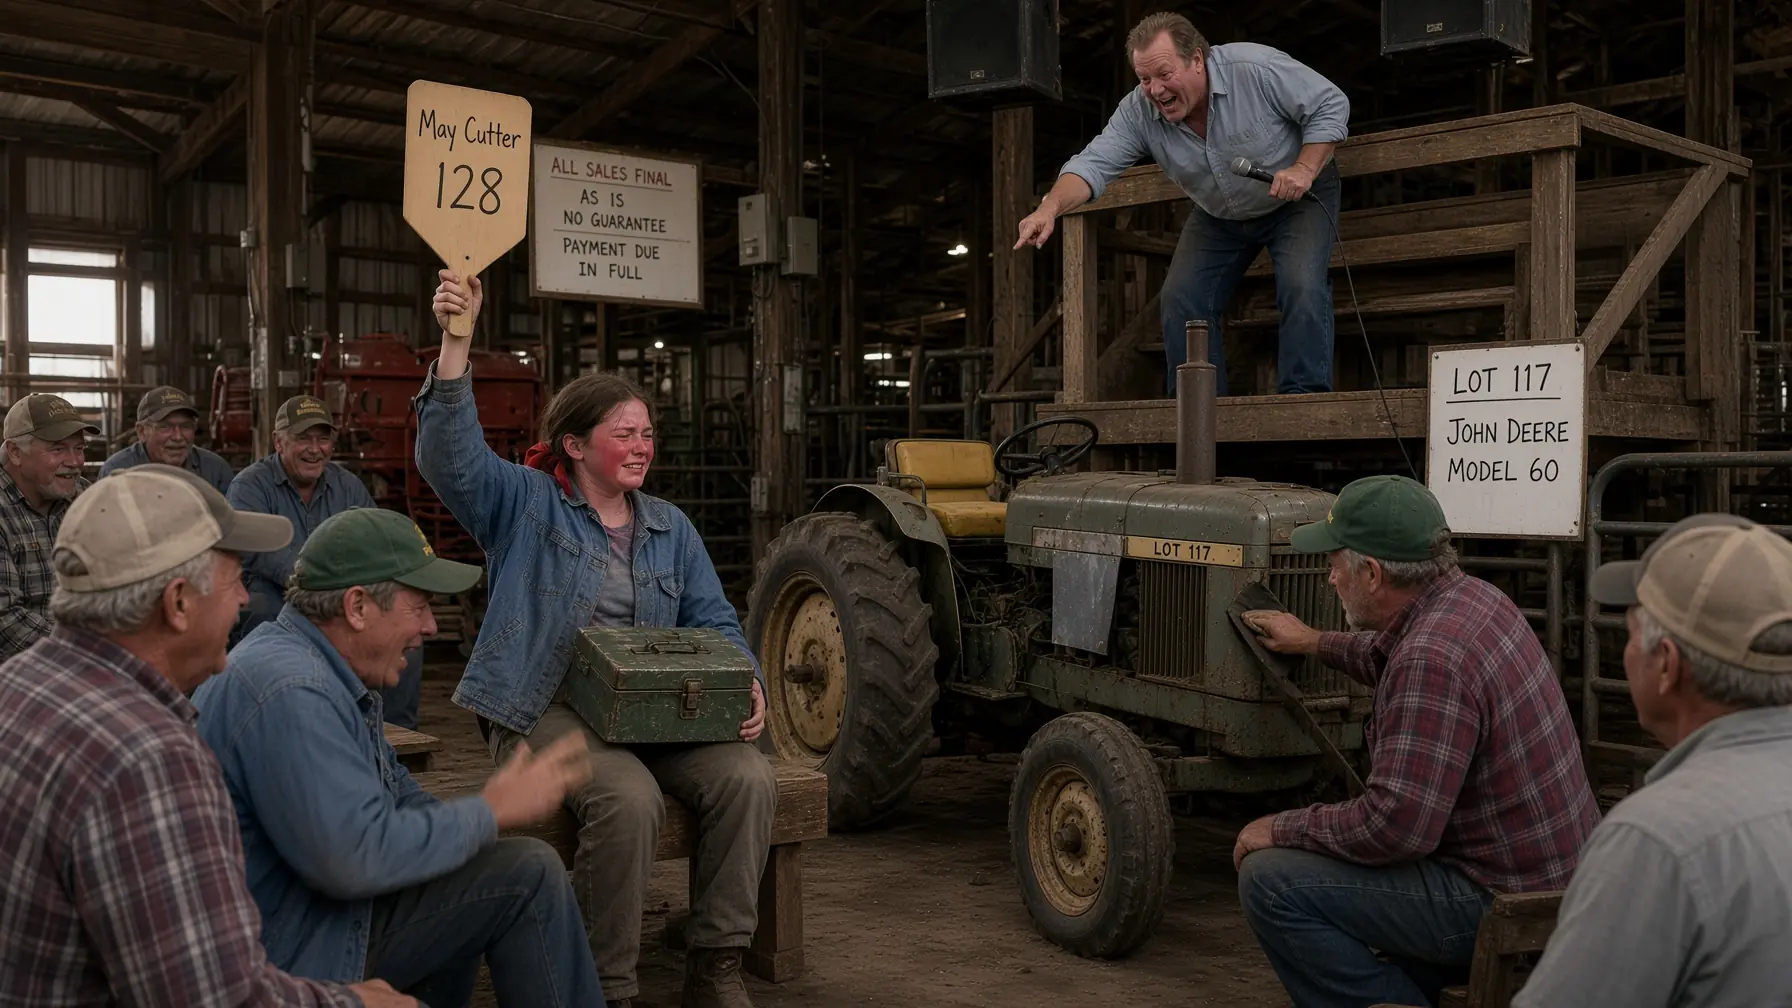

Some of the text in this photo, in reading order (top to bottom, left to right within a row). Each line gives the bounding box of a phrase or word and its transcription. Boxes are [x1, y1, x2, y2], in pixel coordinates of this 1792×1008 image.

[418, 109, 521, 151] May Cutter
[551, 157, 672, 187] ALL SALES FINAL
[436, 161, 503, 215] 128
[580, 189, 624, 208] AS IS
[564, 210, 667, 233] NO GUARANTEE
[563, 238, 660, 260] PAYMENT DUE
[579, 262, 643, 280] IN FULL
[1454, 363, 1551, 395] LOT 117
[1447, 418, 1569, 445] JOHN DEERE
[1448, 457, 1559, 482] MODEL 60
[1154, 541, 1211, 561] LOT 117
